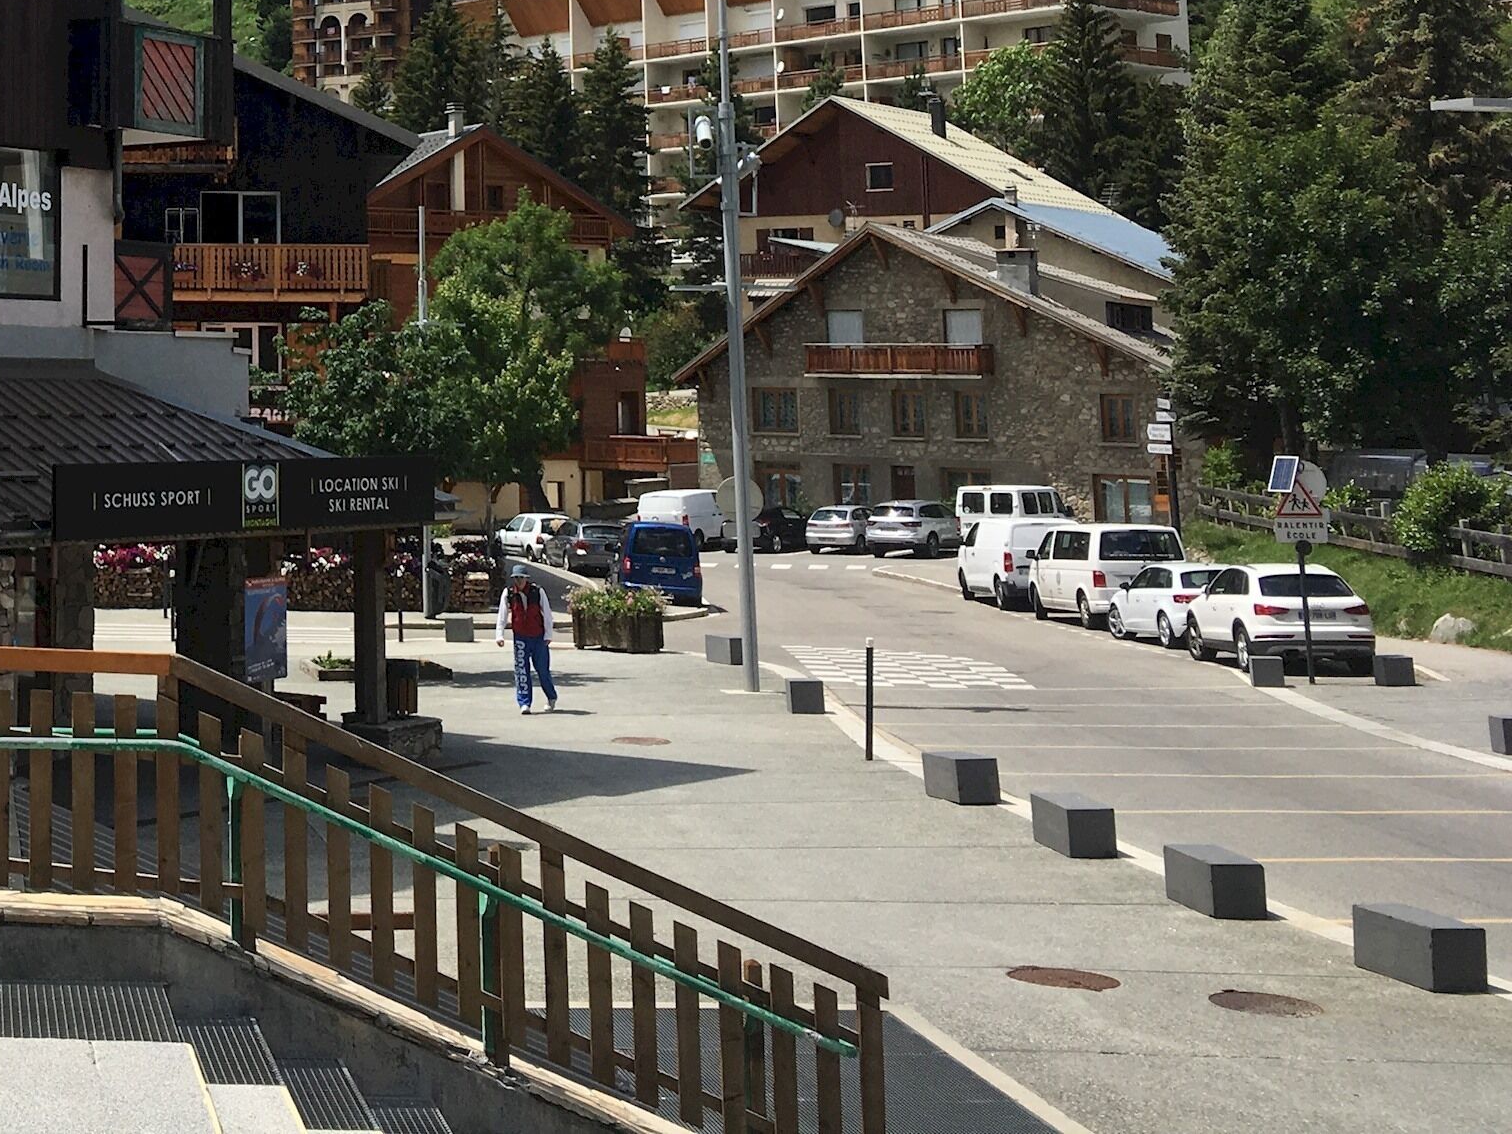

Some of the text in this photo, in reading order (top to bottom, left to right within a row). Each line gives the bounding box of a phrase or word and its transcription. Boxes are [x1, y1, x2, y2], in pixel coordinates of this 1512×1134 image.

[244, 467, 277, 501] GO
[318, 476, 399, 493] LOCATION SKI
[104, 490, 201, 508] SCHUSS SPORT
[328, 497, 390, 512] SKI RENTAL
[245, 503, 276, 514] SPORT
